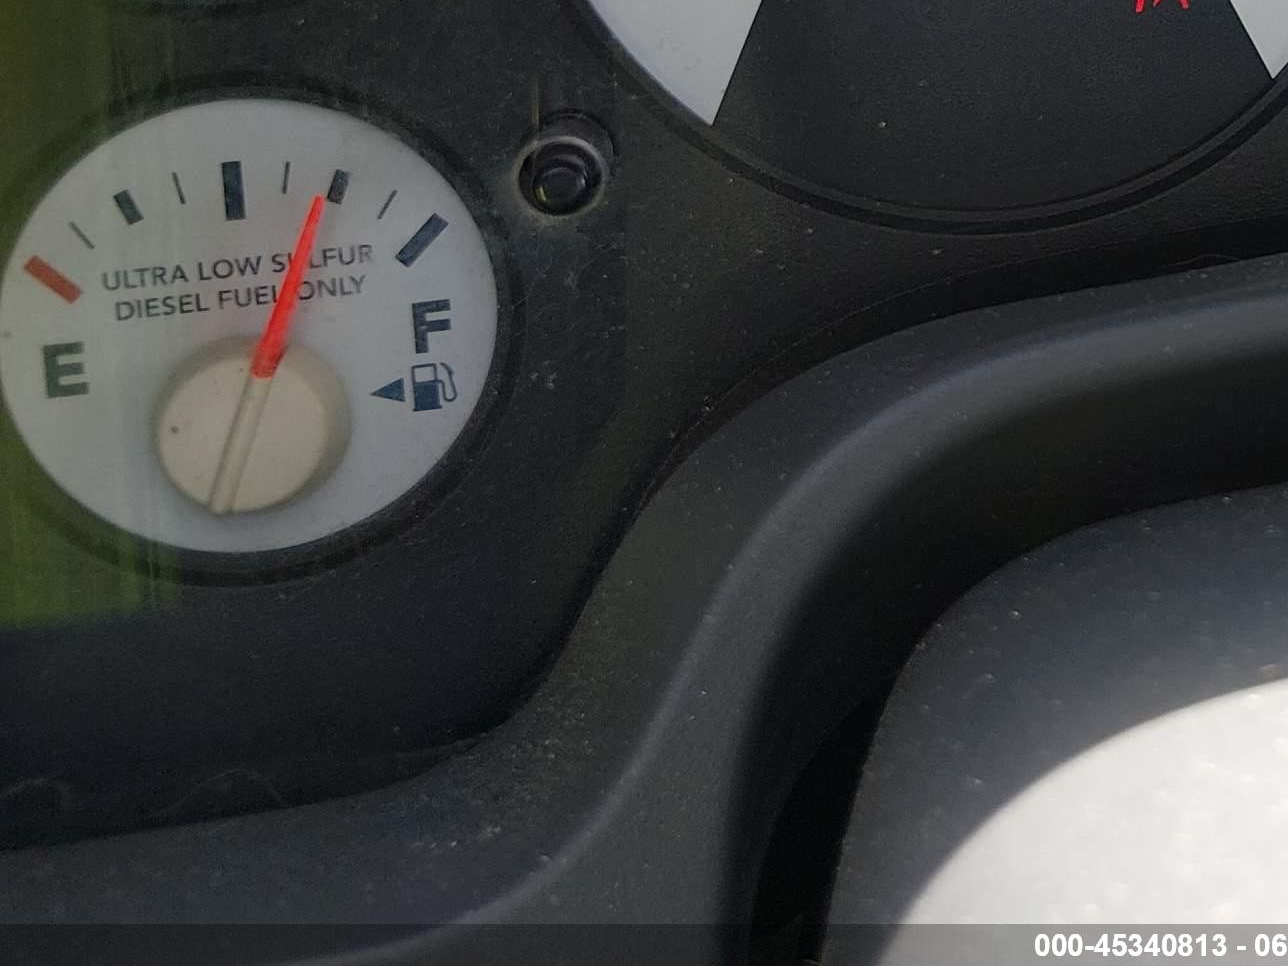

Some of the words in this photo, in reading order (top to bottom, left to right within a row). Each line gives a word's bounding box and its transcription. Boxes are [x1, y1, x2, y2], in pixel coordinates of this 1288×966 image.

[102, 264, 189, 291] ULTRA
[196, 255, 263, 281] LOW
[115, 293, 210, 321] DIESEL
[298, 274, 367, 301] ONLY
[412, 299, 452, 354] F
[43, 341, 90, 399] E
